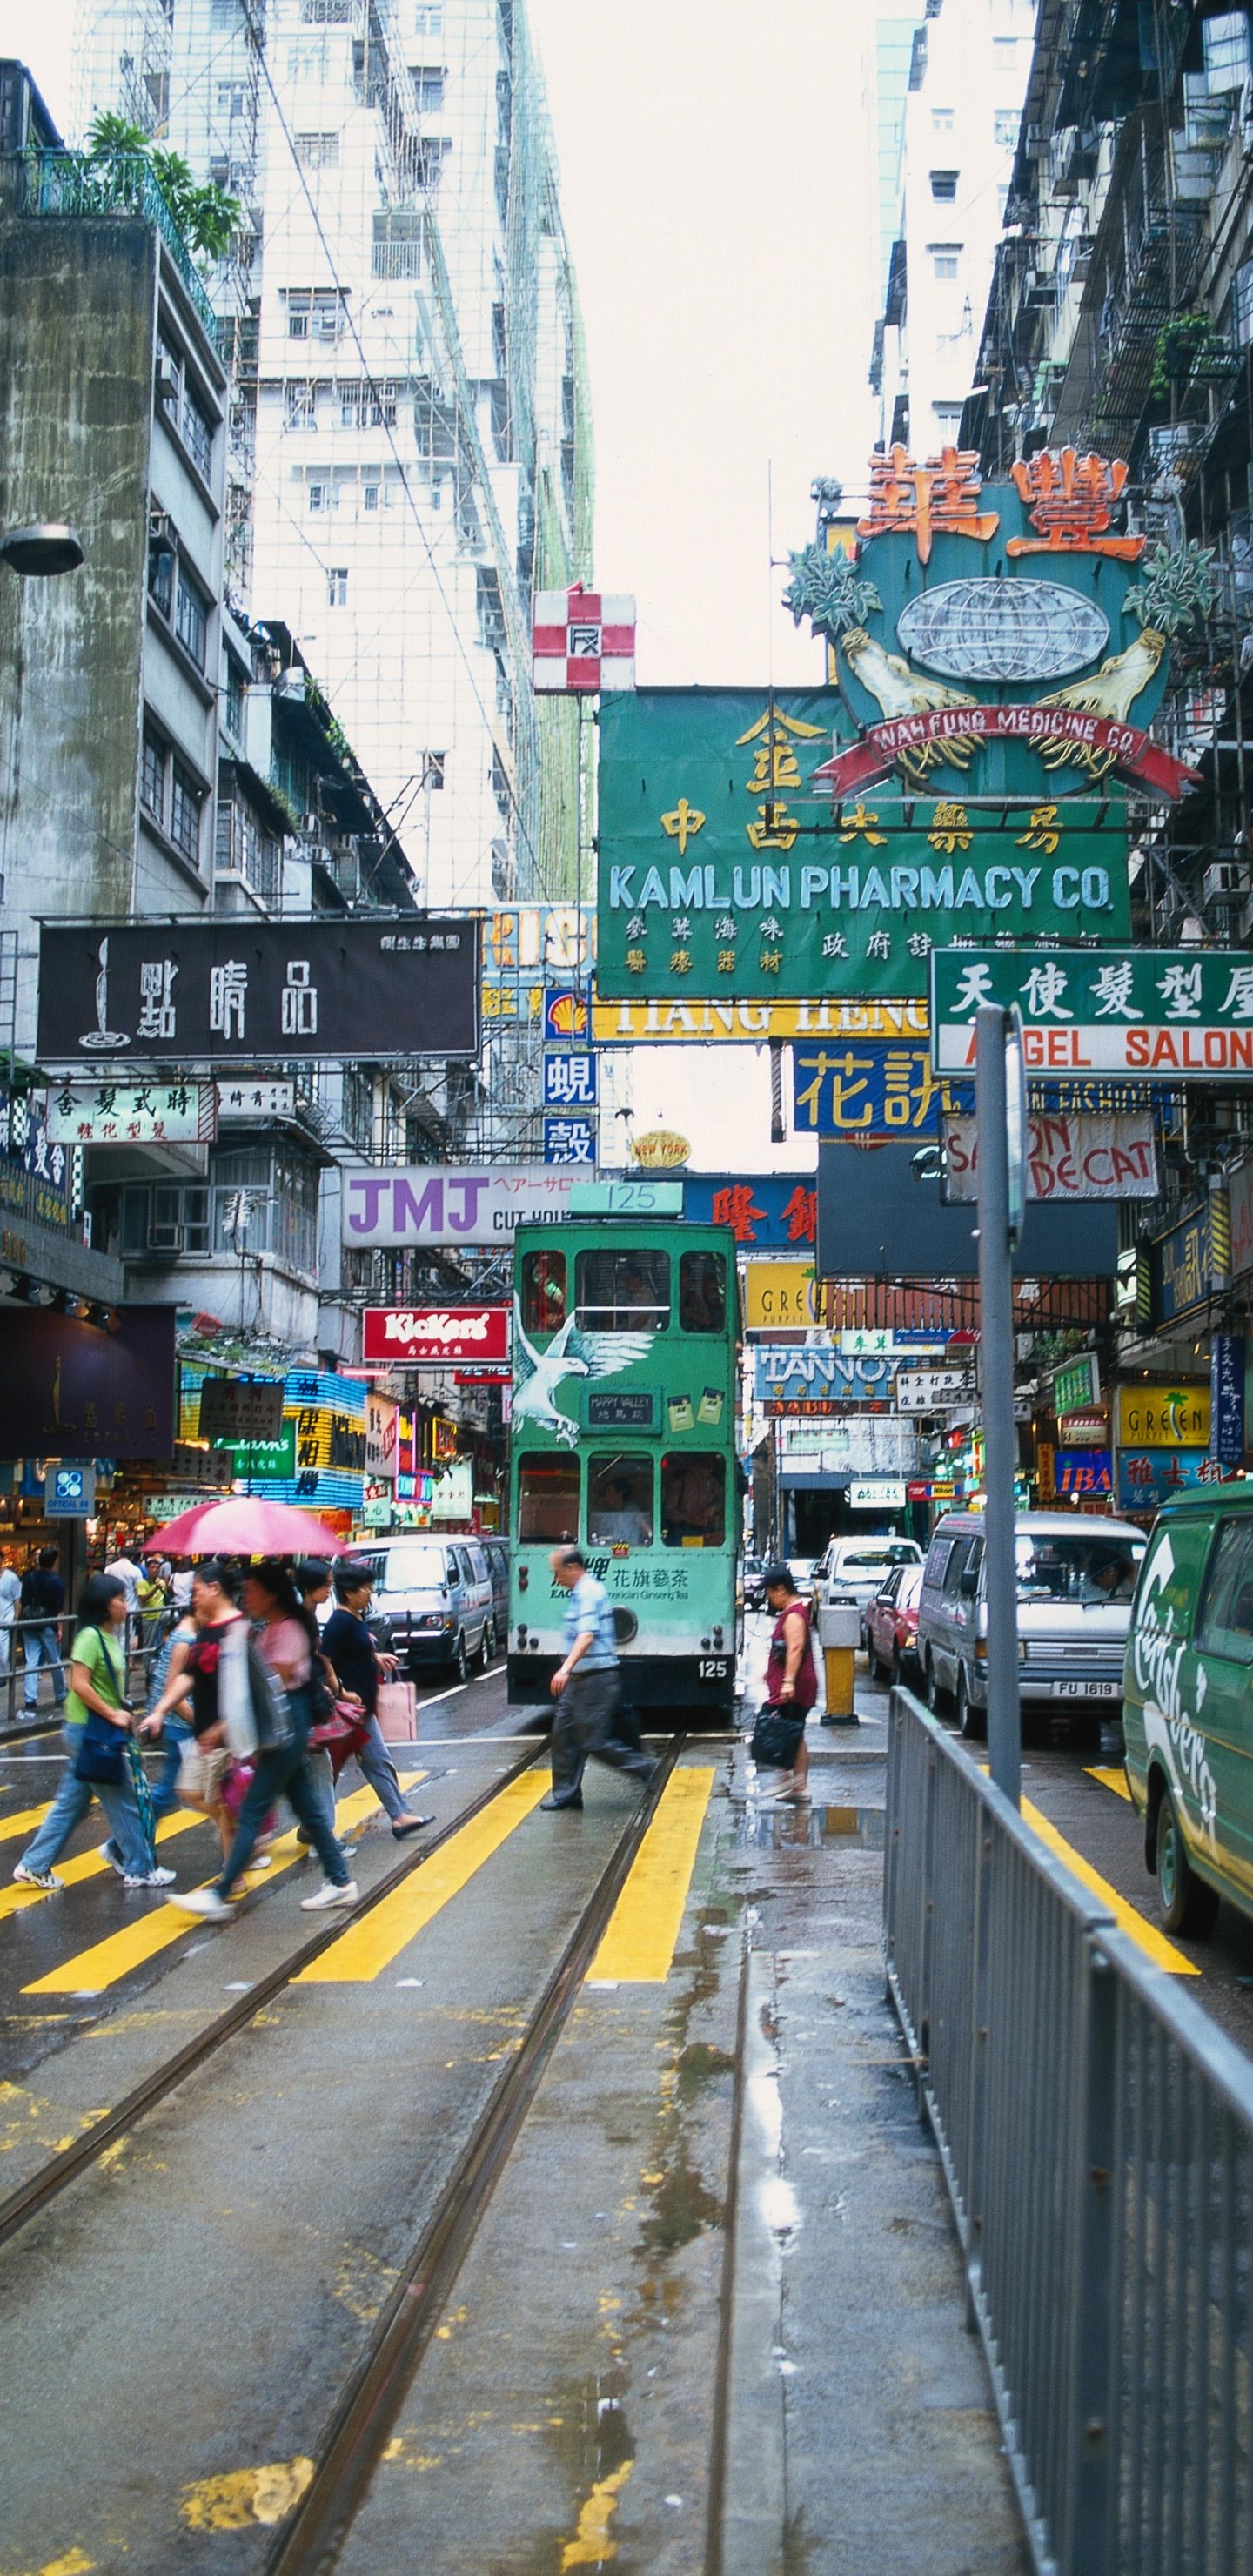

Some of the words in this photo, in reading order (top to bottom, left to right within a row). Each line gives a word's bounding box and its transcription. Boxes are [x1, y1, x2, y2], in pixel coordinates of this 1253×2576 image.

[855, 441, 1148, 565] 華豐
[873, 719, 925, 750] WAH
[930, 710, 985, 740] FUNG
[997, 709, 1095, 741] MEDICINE
[735, 705, 828, 794] 金
[609, 864, 791, 909] KAMLUN
[800, 864, 1042, 910] PHARMACY
[1052, 865, 1115, 911] CO.
[1125, 1030, 1253, 1069] SALON
[349, 1177, 490, 1233] JMJ
[608, 1184, 656, 1210] 125
[493, 1211, 526, 1231] CUT
[591, 1396, 618, 1408] HAPPY
[621, 1396, 649, 1408] VALLEY
[1129, 1409, 1203, 1432] GREEN
[606, 1590, 639, 1599] merican
[640, 1591, 675, 1601] Ginseng
[676, 1591, 688, 1600] Tea
[699, 1660, 727, 1678] 125
[1059, 1683, 1078, 1694] FU
[1084, 1683, 1113, 1694] 1619
